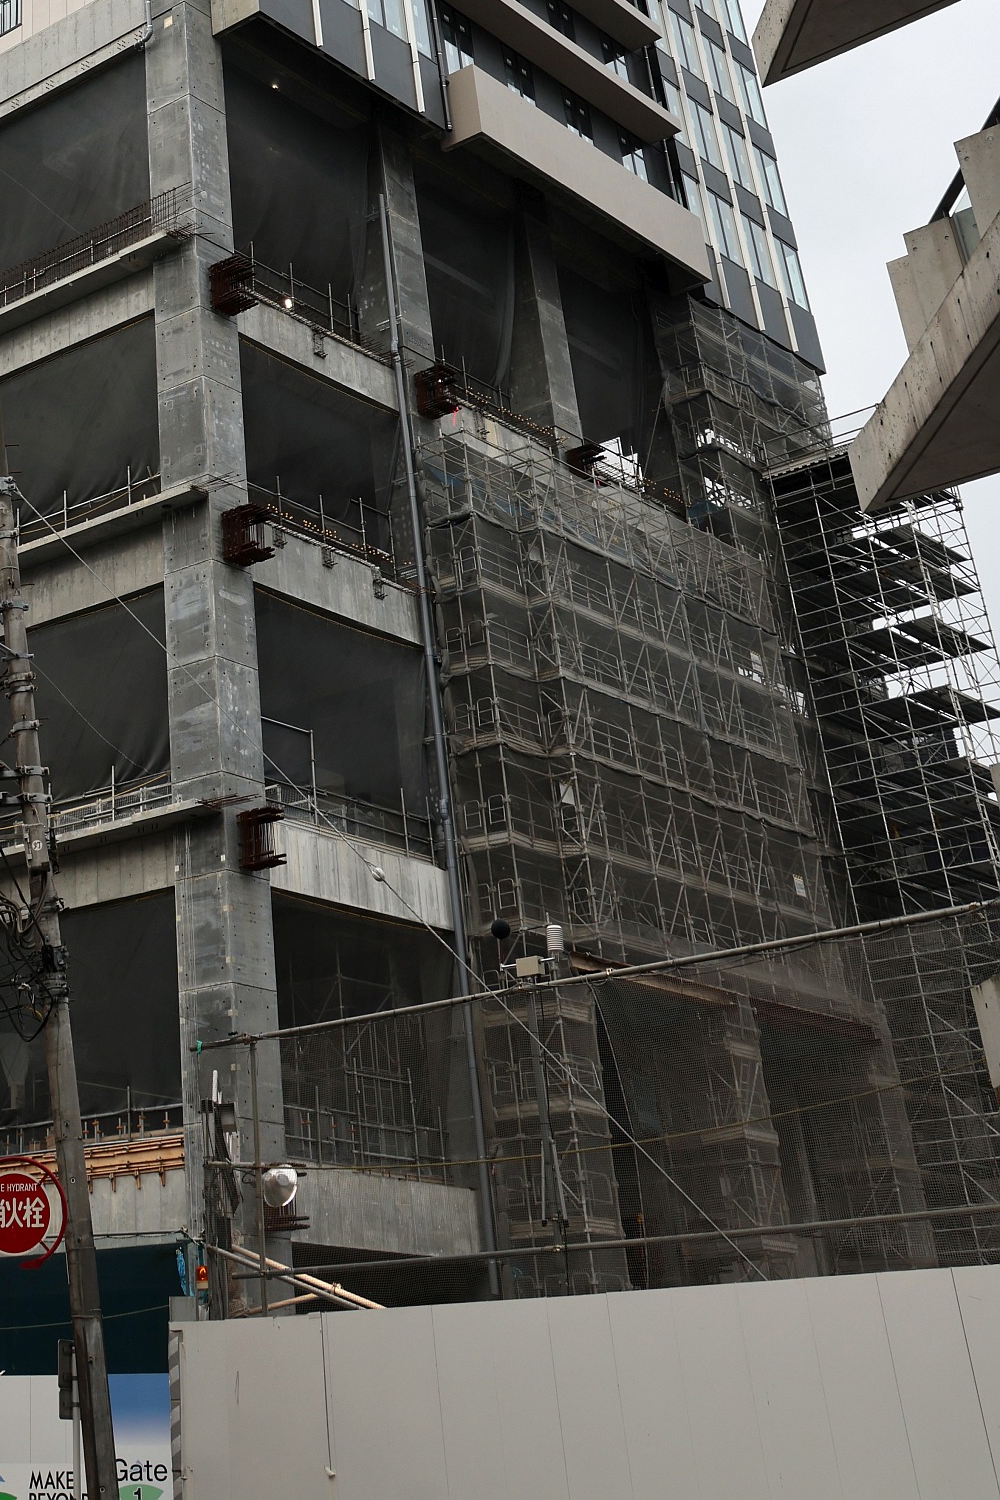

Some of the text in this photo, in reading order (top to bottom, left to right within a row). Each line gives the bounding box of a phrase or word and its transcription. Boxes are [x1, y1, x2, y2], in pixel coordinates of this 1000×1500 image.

[7, 1184, 37, 1192] HYDRANT
[116, 1458, 168, 1482] Gate
[29, 1471, 73, 1489] MAKE
